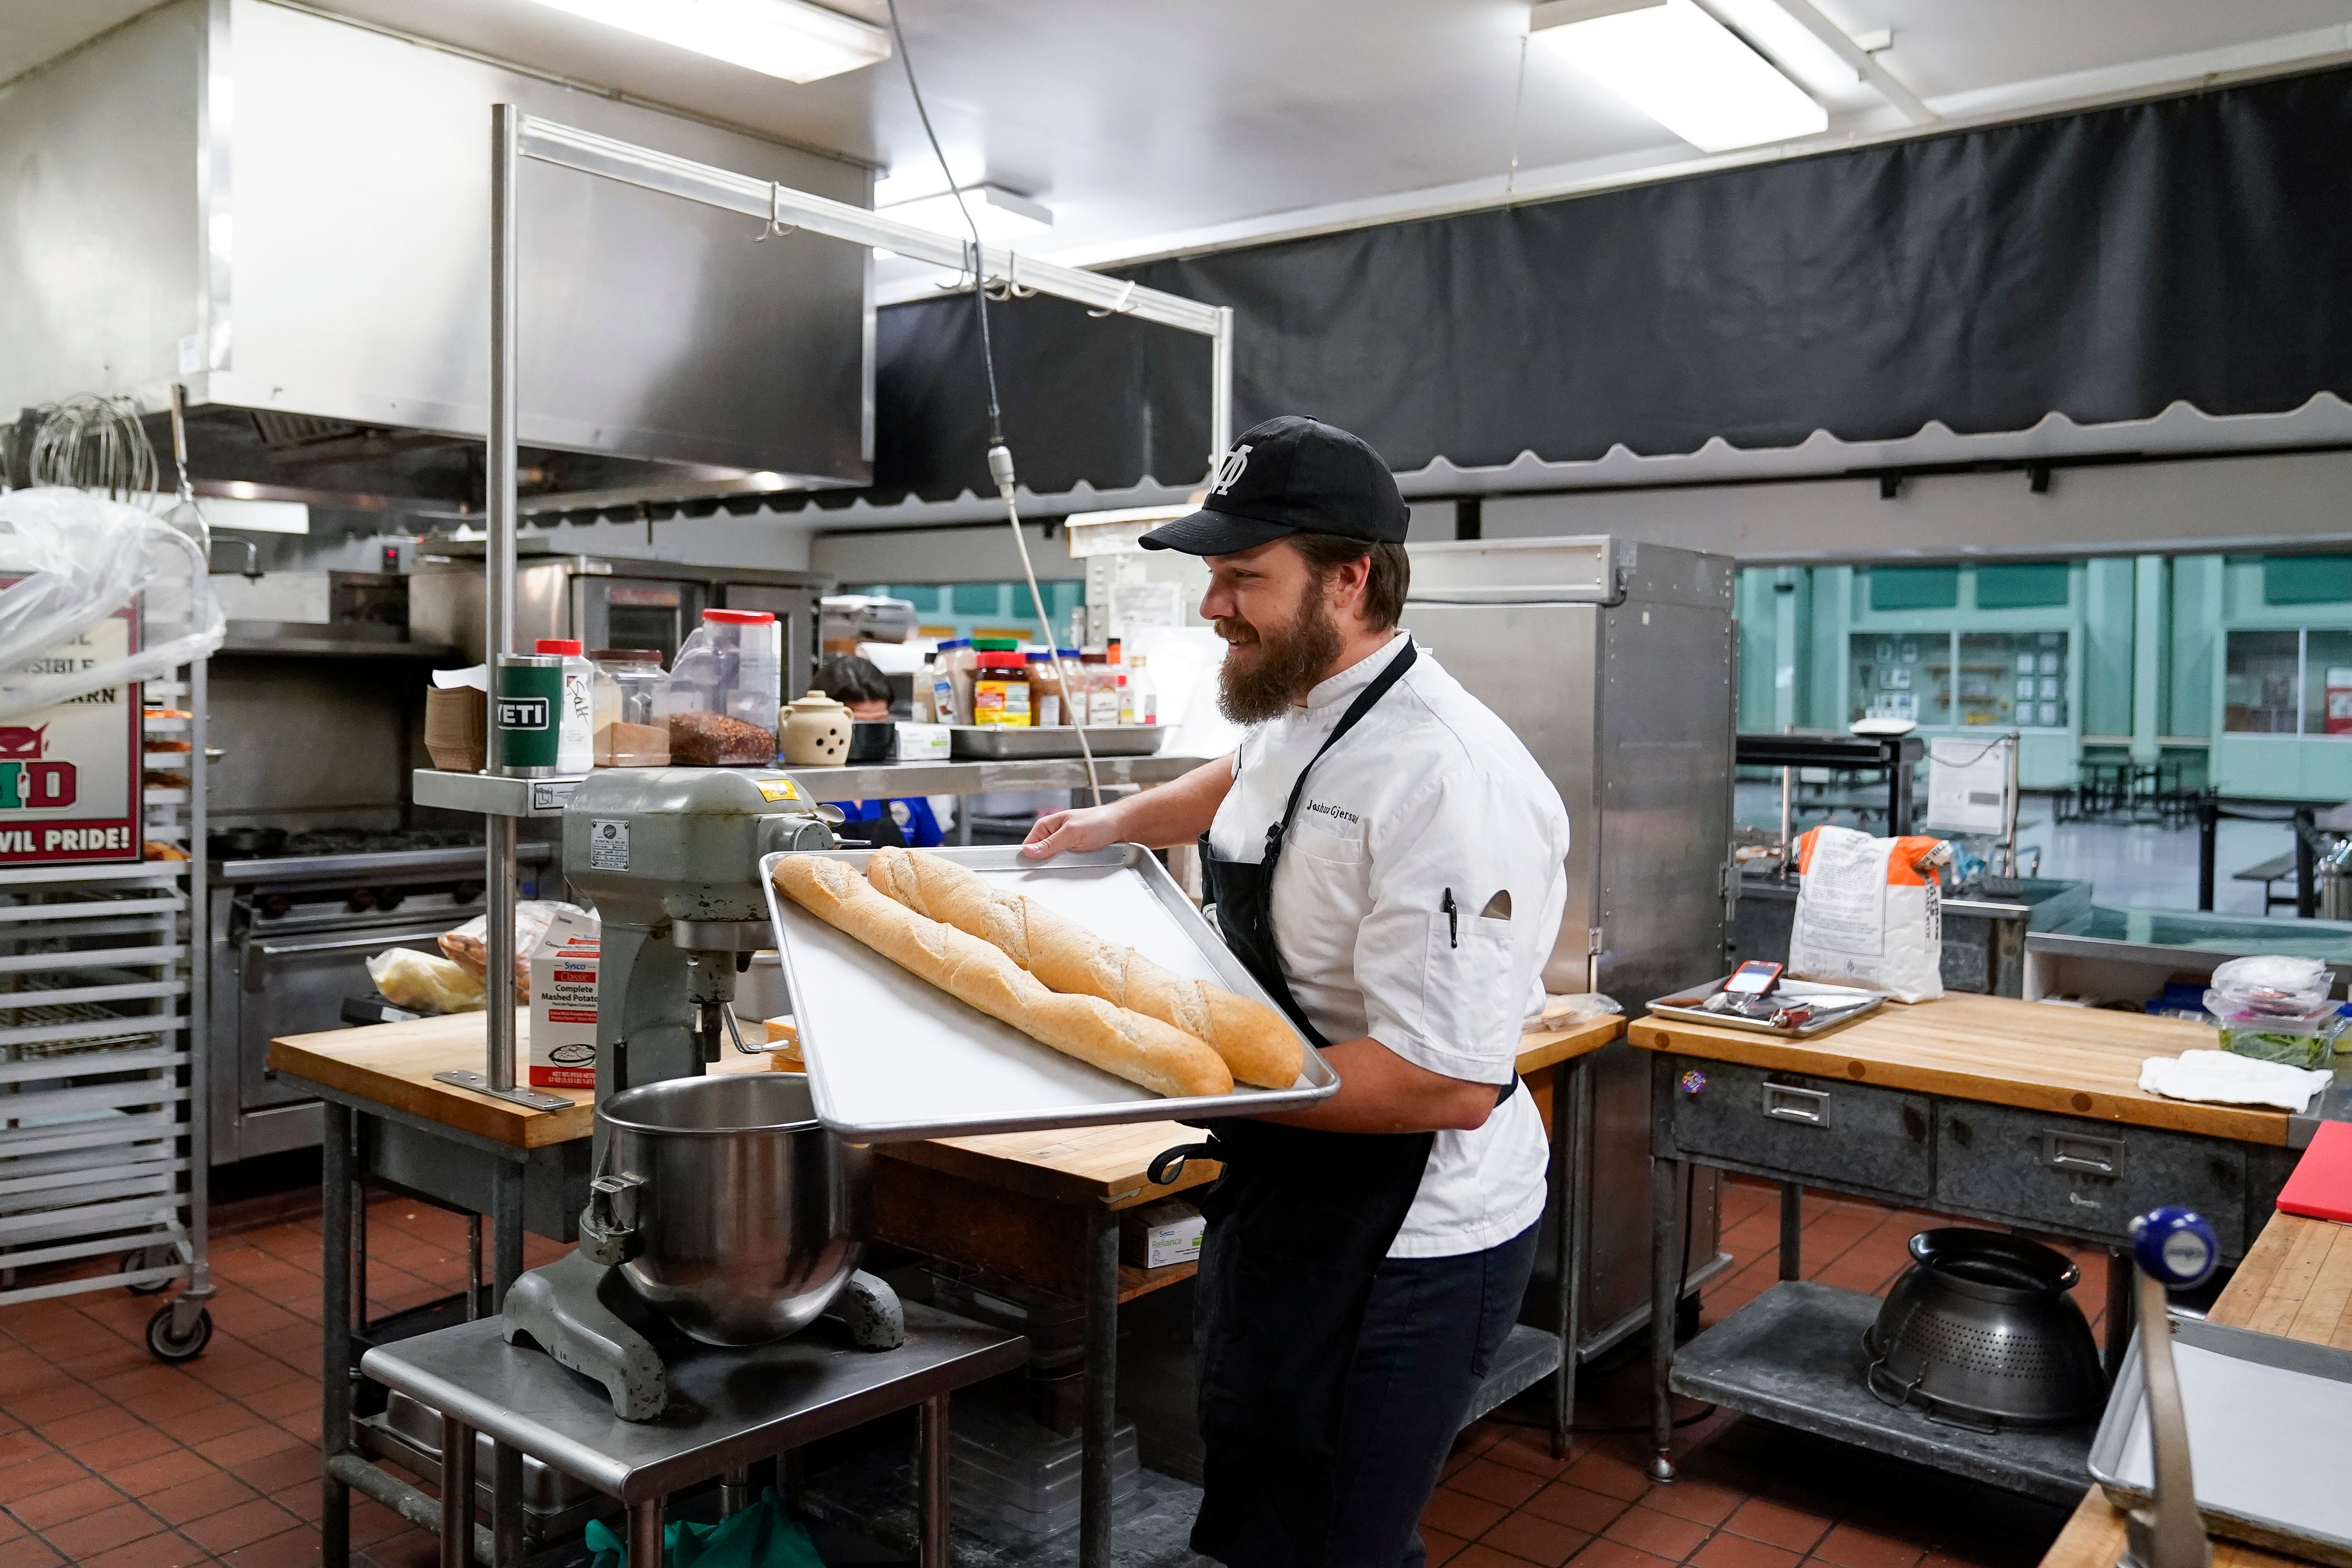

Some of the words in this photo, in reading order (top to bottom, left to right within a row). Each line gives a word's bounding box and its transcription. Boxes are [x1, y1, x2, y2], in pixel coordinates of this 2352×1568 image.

[45, 826, 130, 852] PRIDE!
[564, 962, 586, 971] Sysco
[556, 984, 593, 993] Complete
[541, 993, 571, 1001] Mashed
[1152, 1238, 1183, 1248] Reliance
